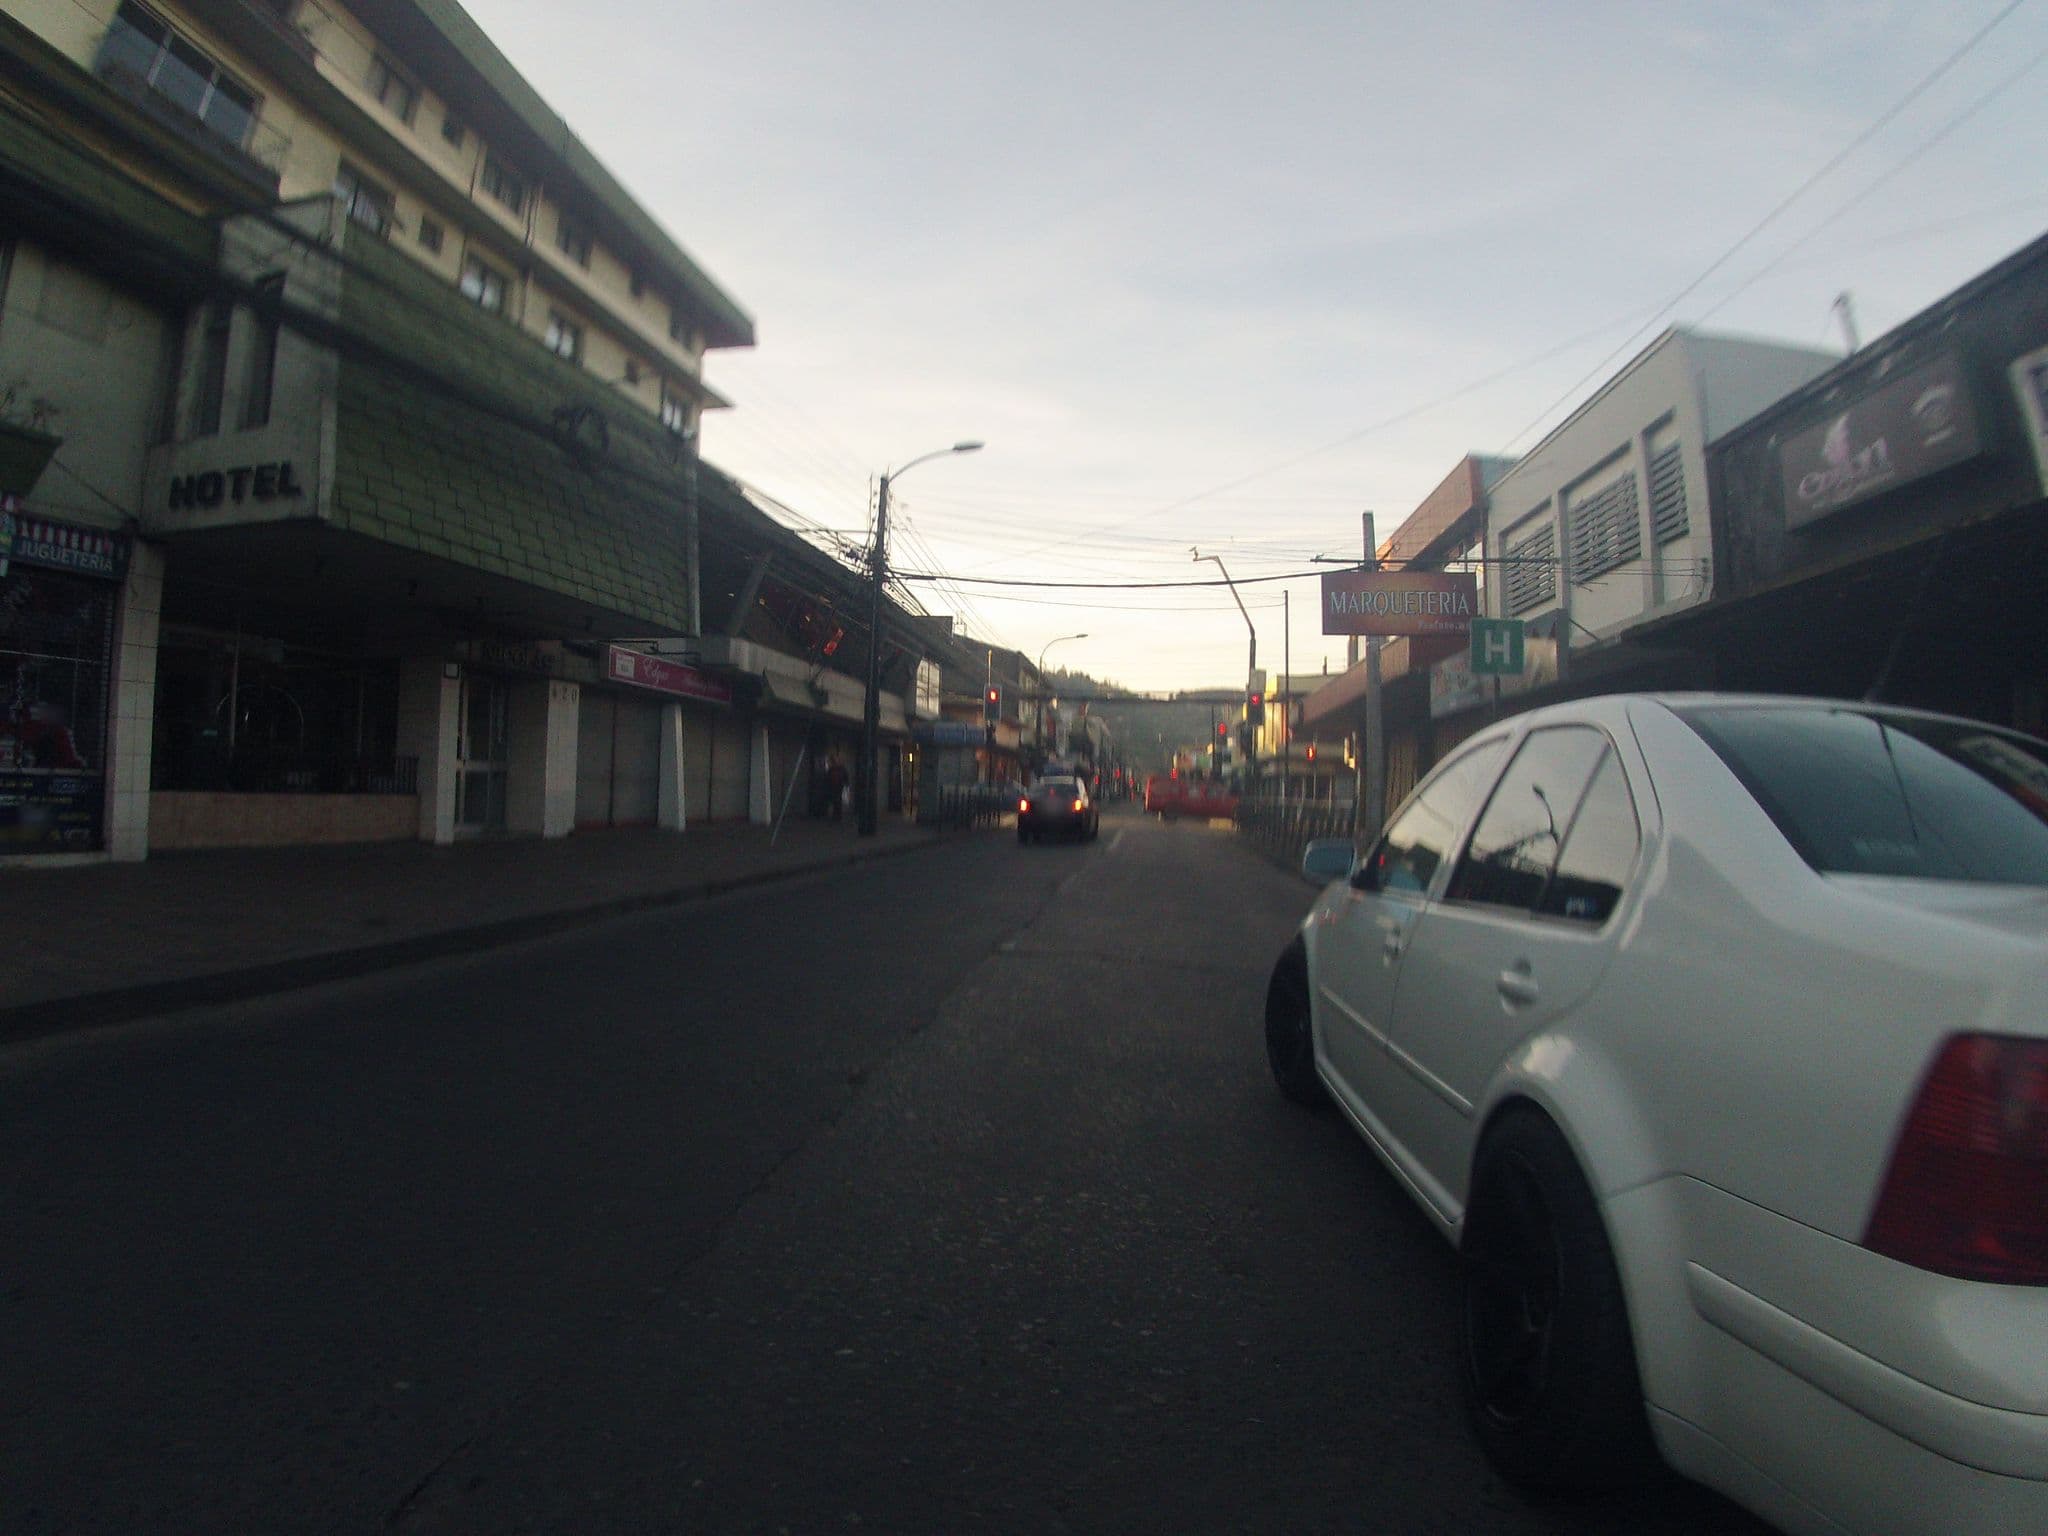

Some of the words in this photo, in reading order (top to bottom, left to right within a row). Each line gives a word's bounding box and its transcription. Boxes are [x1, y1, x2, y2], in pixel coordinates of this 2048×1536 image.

[168, 460, 303, 510] HOTEL
[1330, 584, 1471, 617] MARQUETERÍA
[1484, 630, 1510, 664] H
